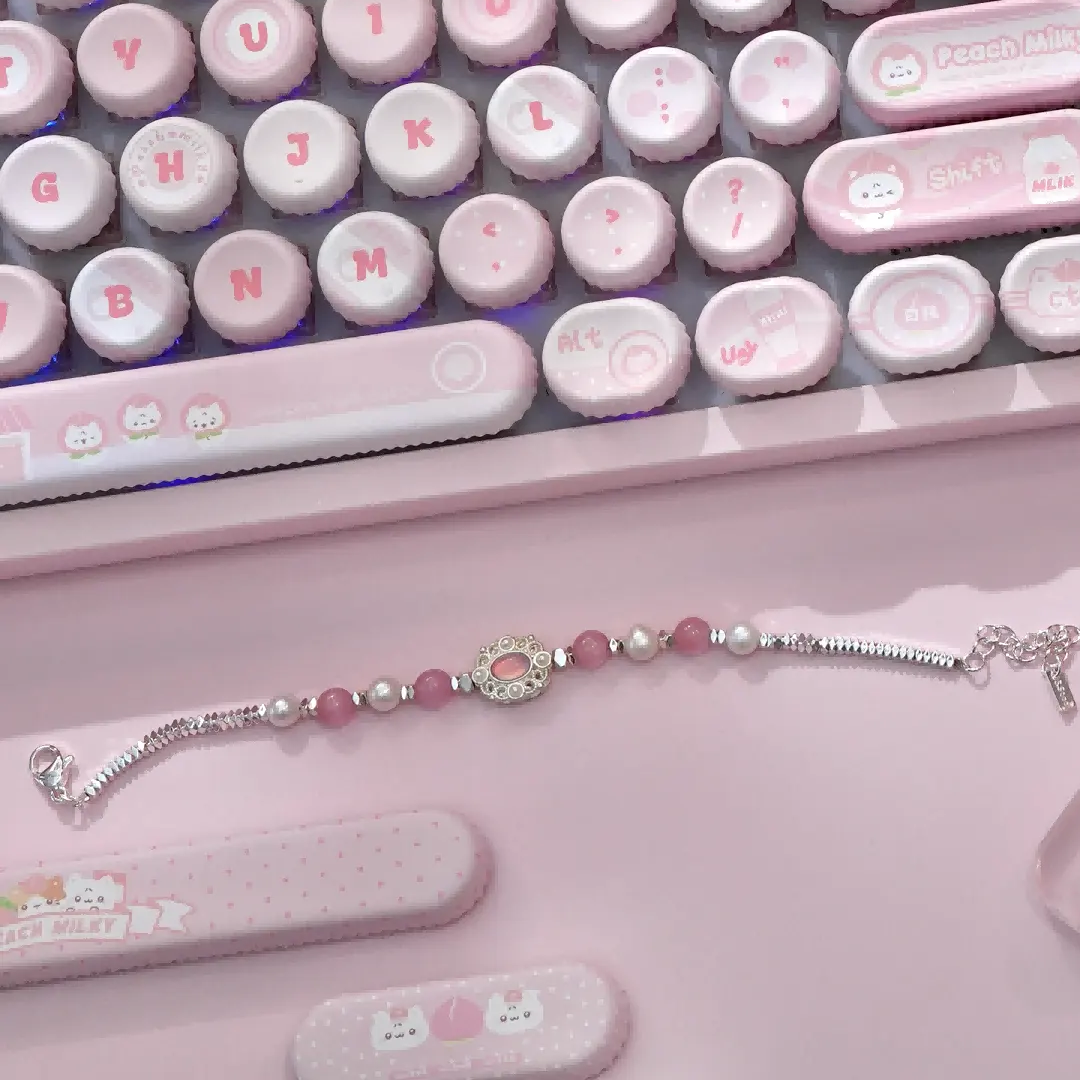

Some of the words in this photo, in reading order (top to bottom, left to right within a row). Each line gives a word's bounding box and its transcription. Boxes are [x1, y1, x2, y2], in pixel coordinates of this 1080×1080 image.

[239, 21, 268, 52] U
[112, 38, 142, 70] Y
[528, 101, 553, 131] L
[287, 133, 310, 167] J
[403, 118, 433, 150] K
[154, 150, 184, 183] H
[926, 151, 1005, 193] Shift
[31, 172, 59, 203] G
[352, 247, 388, 281] M
[229, 266, 262, 301] N
[104, 284, 133, 319] B
